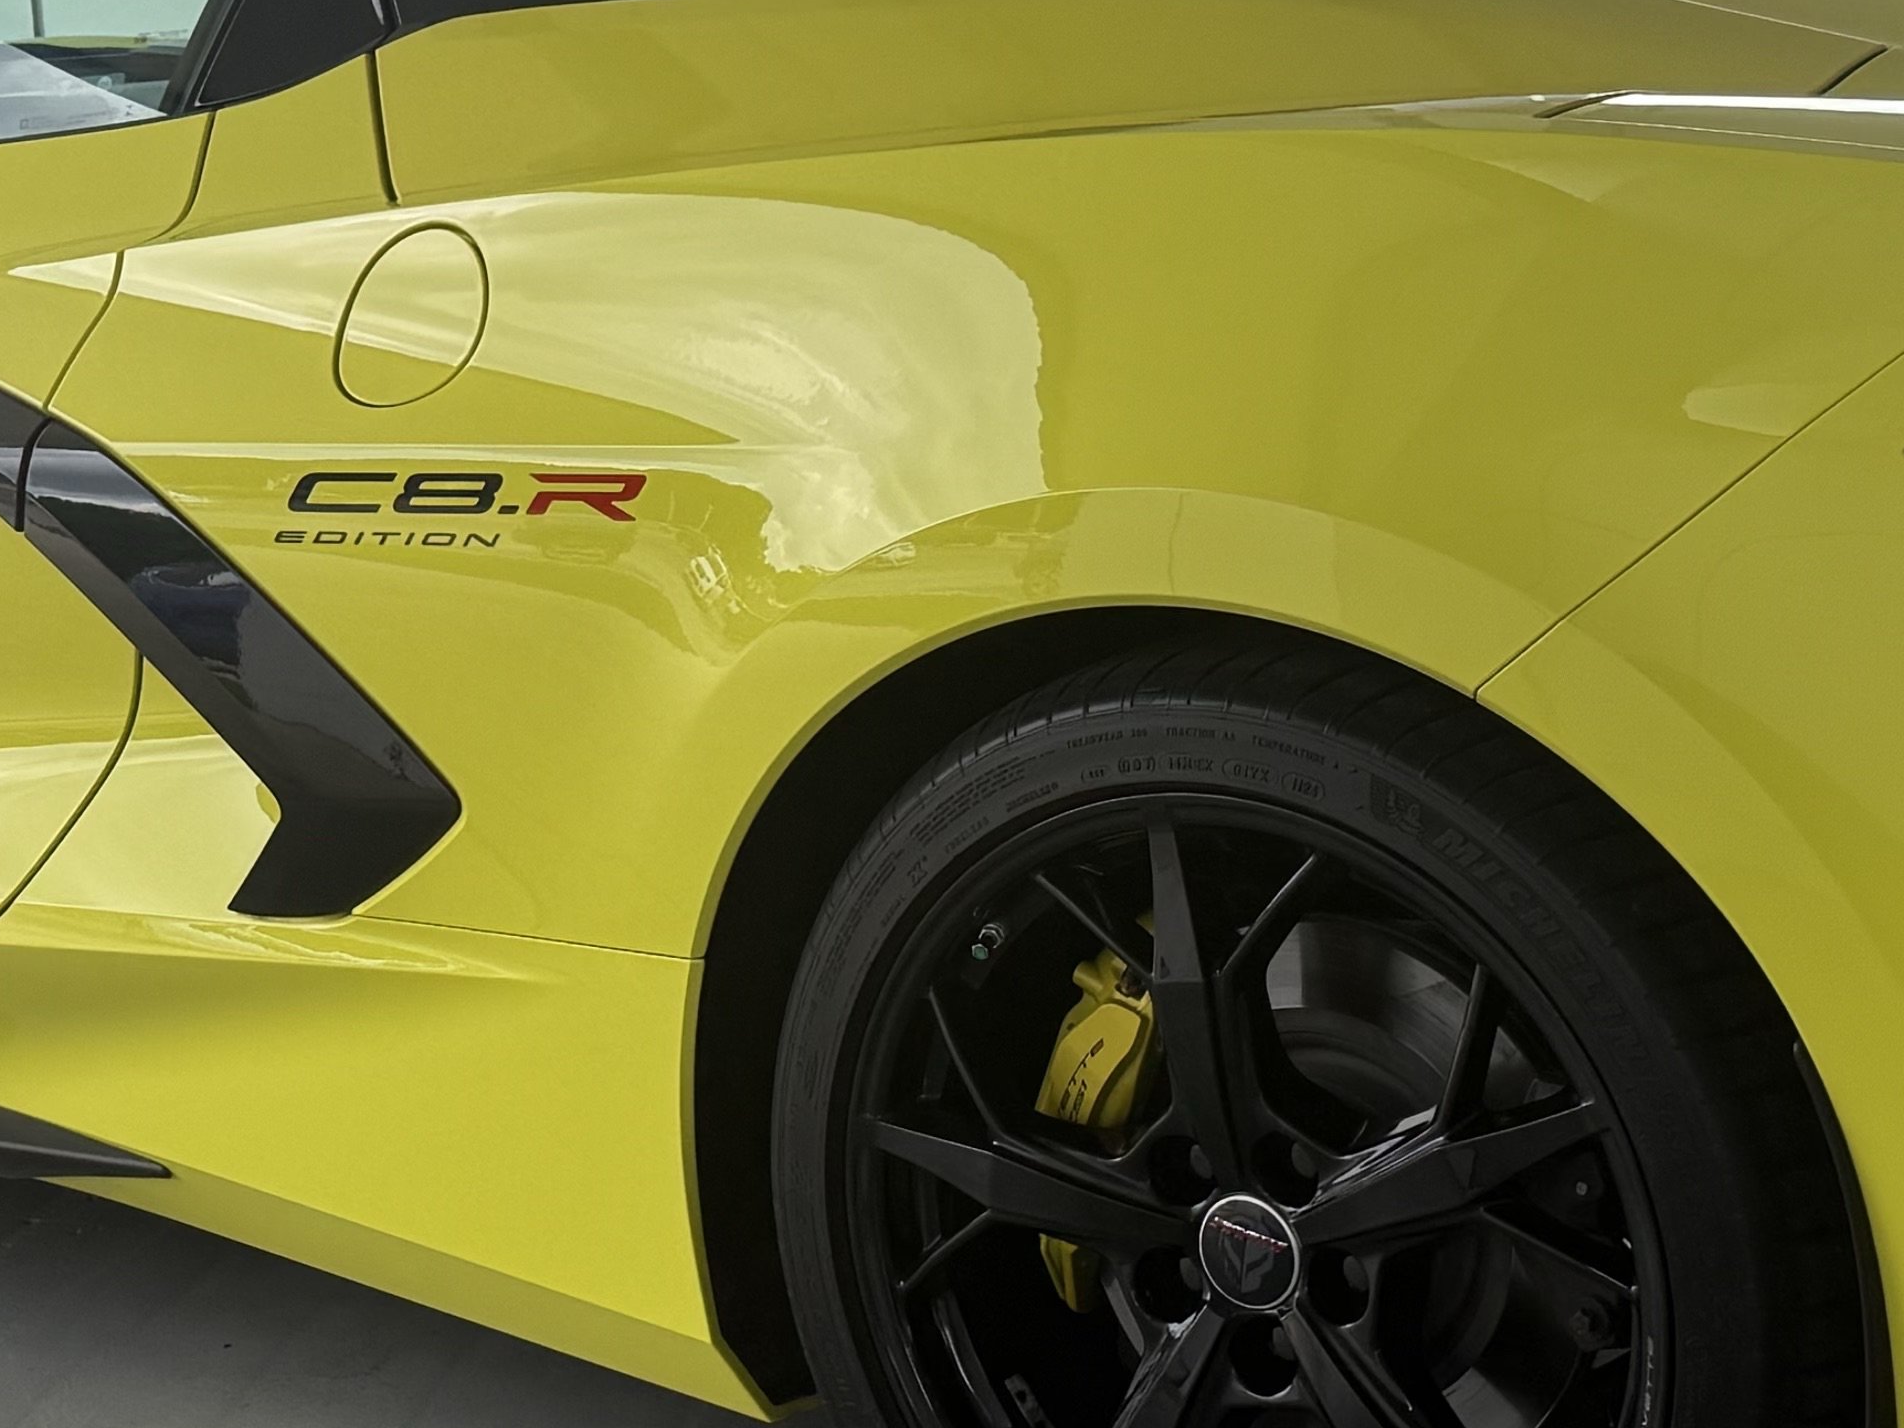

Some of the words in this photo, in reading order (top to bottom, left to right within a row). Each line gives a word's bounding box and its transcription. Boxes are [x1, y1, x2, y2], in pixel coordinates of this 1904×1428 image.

[287, 471, 648, 522] C8.R
[274, 530, 501, 549] EDITION
[1252, 735, 1328, 766] TEMPERATURE
[1432, 828, 1653, 1066] MICHELIN
